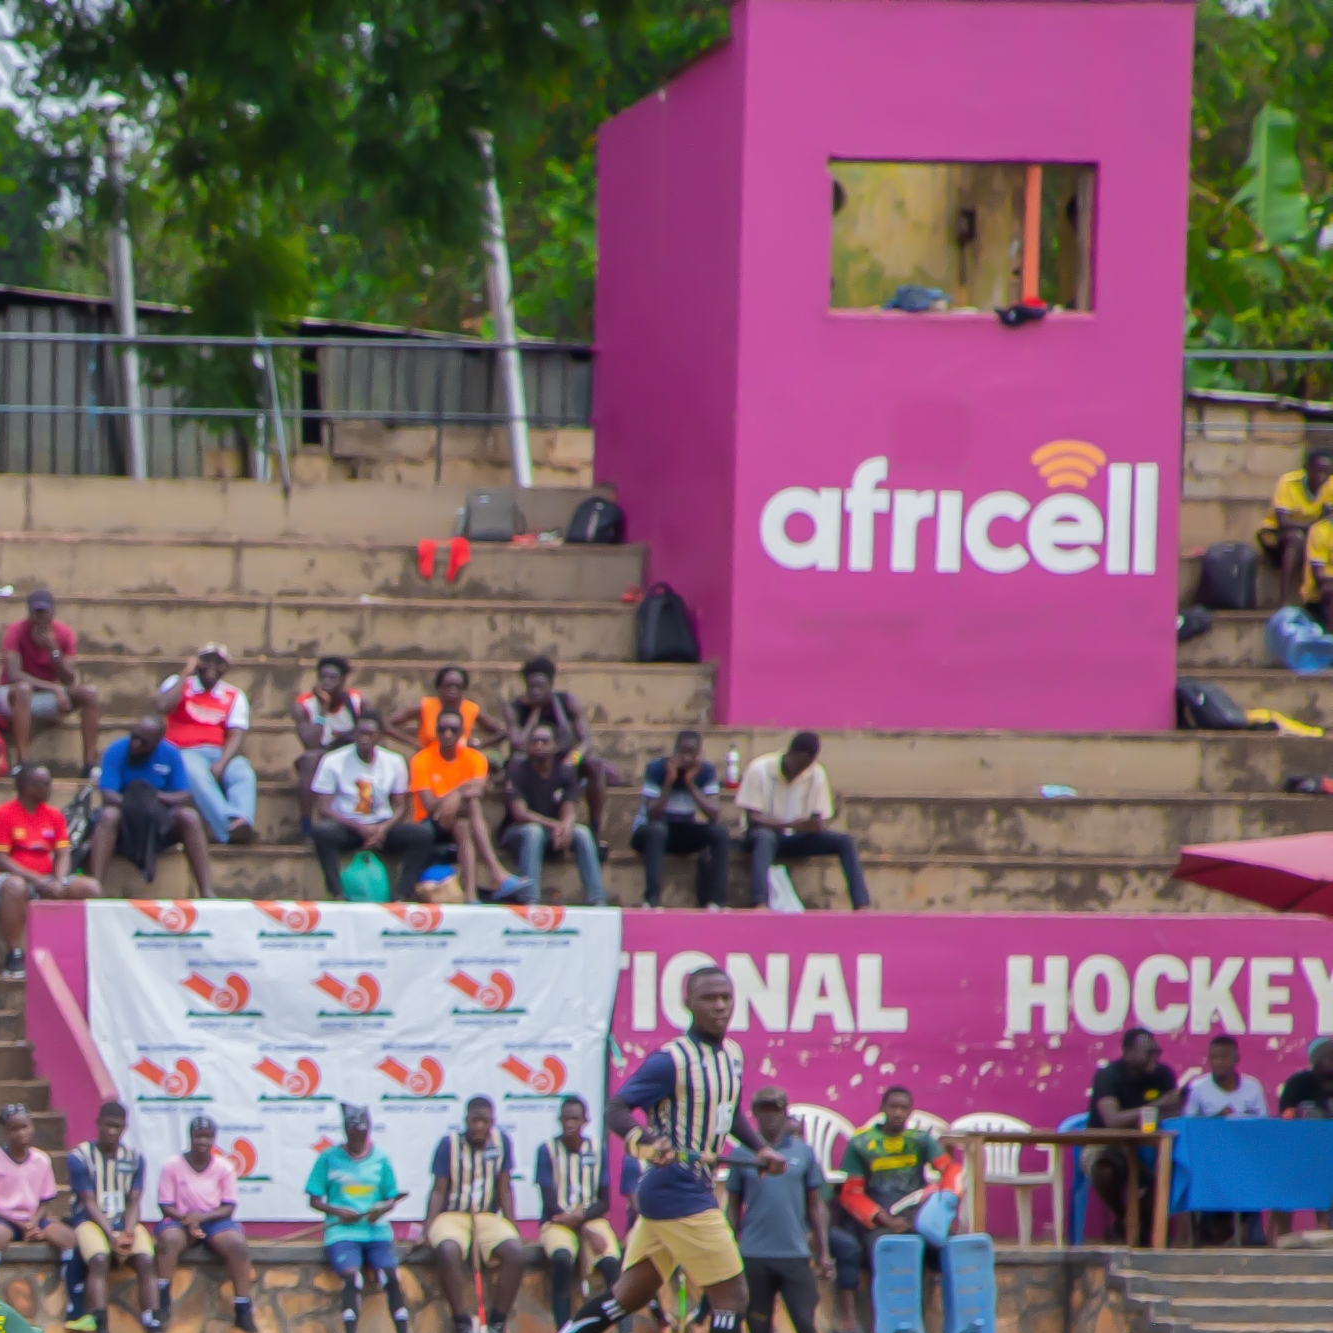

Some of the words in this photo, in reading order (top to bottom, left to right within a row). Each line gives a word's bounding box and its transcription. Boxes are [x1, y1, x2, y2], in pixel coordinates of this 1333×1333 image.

[759, 455, 1159, 575] africell
[618, 950, 909, 1032] IONAL
[1005, 953, 1333, 1036] HOCKEY
